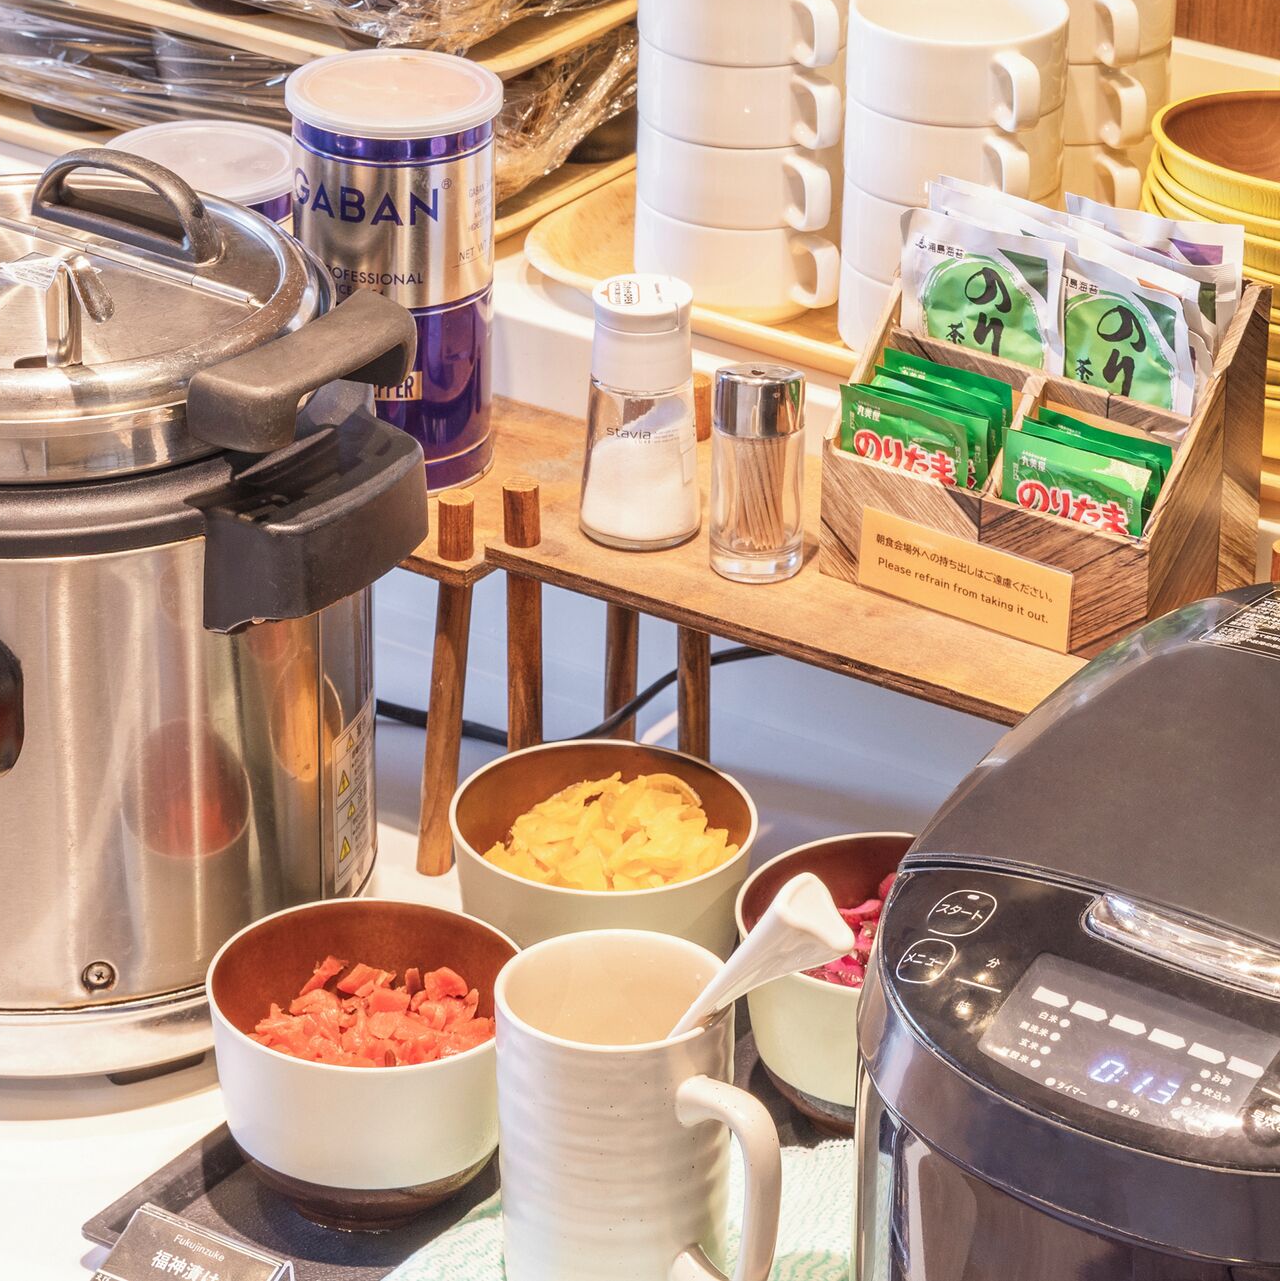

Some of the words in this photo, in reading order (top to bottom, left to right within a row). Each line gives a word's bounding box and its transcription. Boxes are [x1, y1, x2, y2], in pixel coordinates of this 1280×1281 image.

[294, 167, 439, 226] GABAN
[459, 246, 475, 262] NET
[326, 264, 424, 286] OFESSIONAL
[606, 426, 652, 440] stavia
[854, 429, 958, 487] のりたま
[1017, 479, 1130, 536] のりたま
[876, 533, 1054, 603] 朝食会場外への持ち出しはご遠慮ください。
[877, 556, 912, 577] Please
[914, 570, 950, 590] refrain
[952, 582, 978, 600] from
[980, 592, 1014, 612] taking
[1016, 604, 1024, 616] it
[1027, 609, 1049, 624] out.
[935, 903, 984, 921] スタート
[903, 952, 945, 967] メニュー
[985, 957, 1000, 969] 分
[1038, 1011, 1059, 1024] 白米
[1019, 1020, 1049, 1038] 無洗米
[1210, 1070, 1233, 1087] お粥
[1056, 1081, 1088, 1097] タイマー
[1201, 1086, 1232, 1104] 炊込み
[1120, 1104, 1141, 1118] 予約
[173, 1233, 225, 1262] Fukujinzuke
[150, 1249, 220, 1281] 福神漬け
